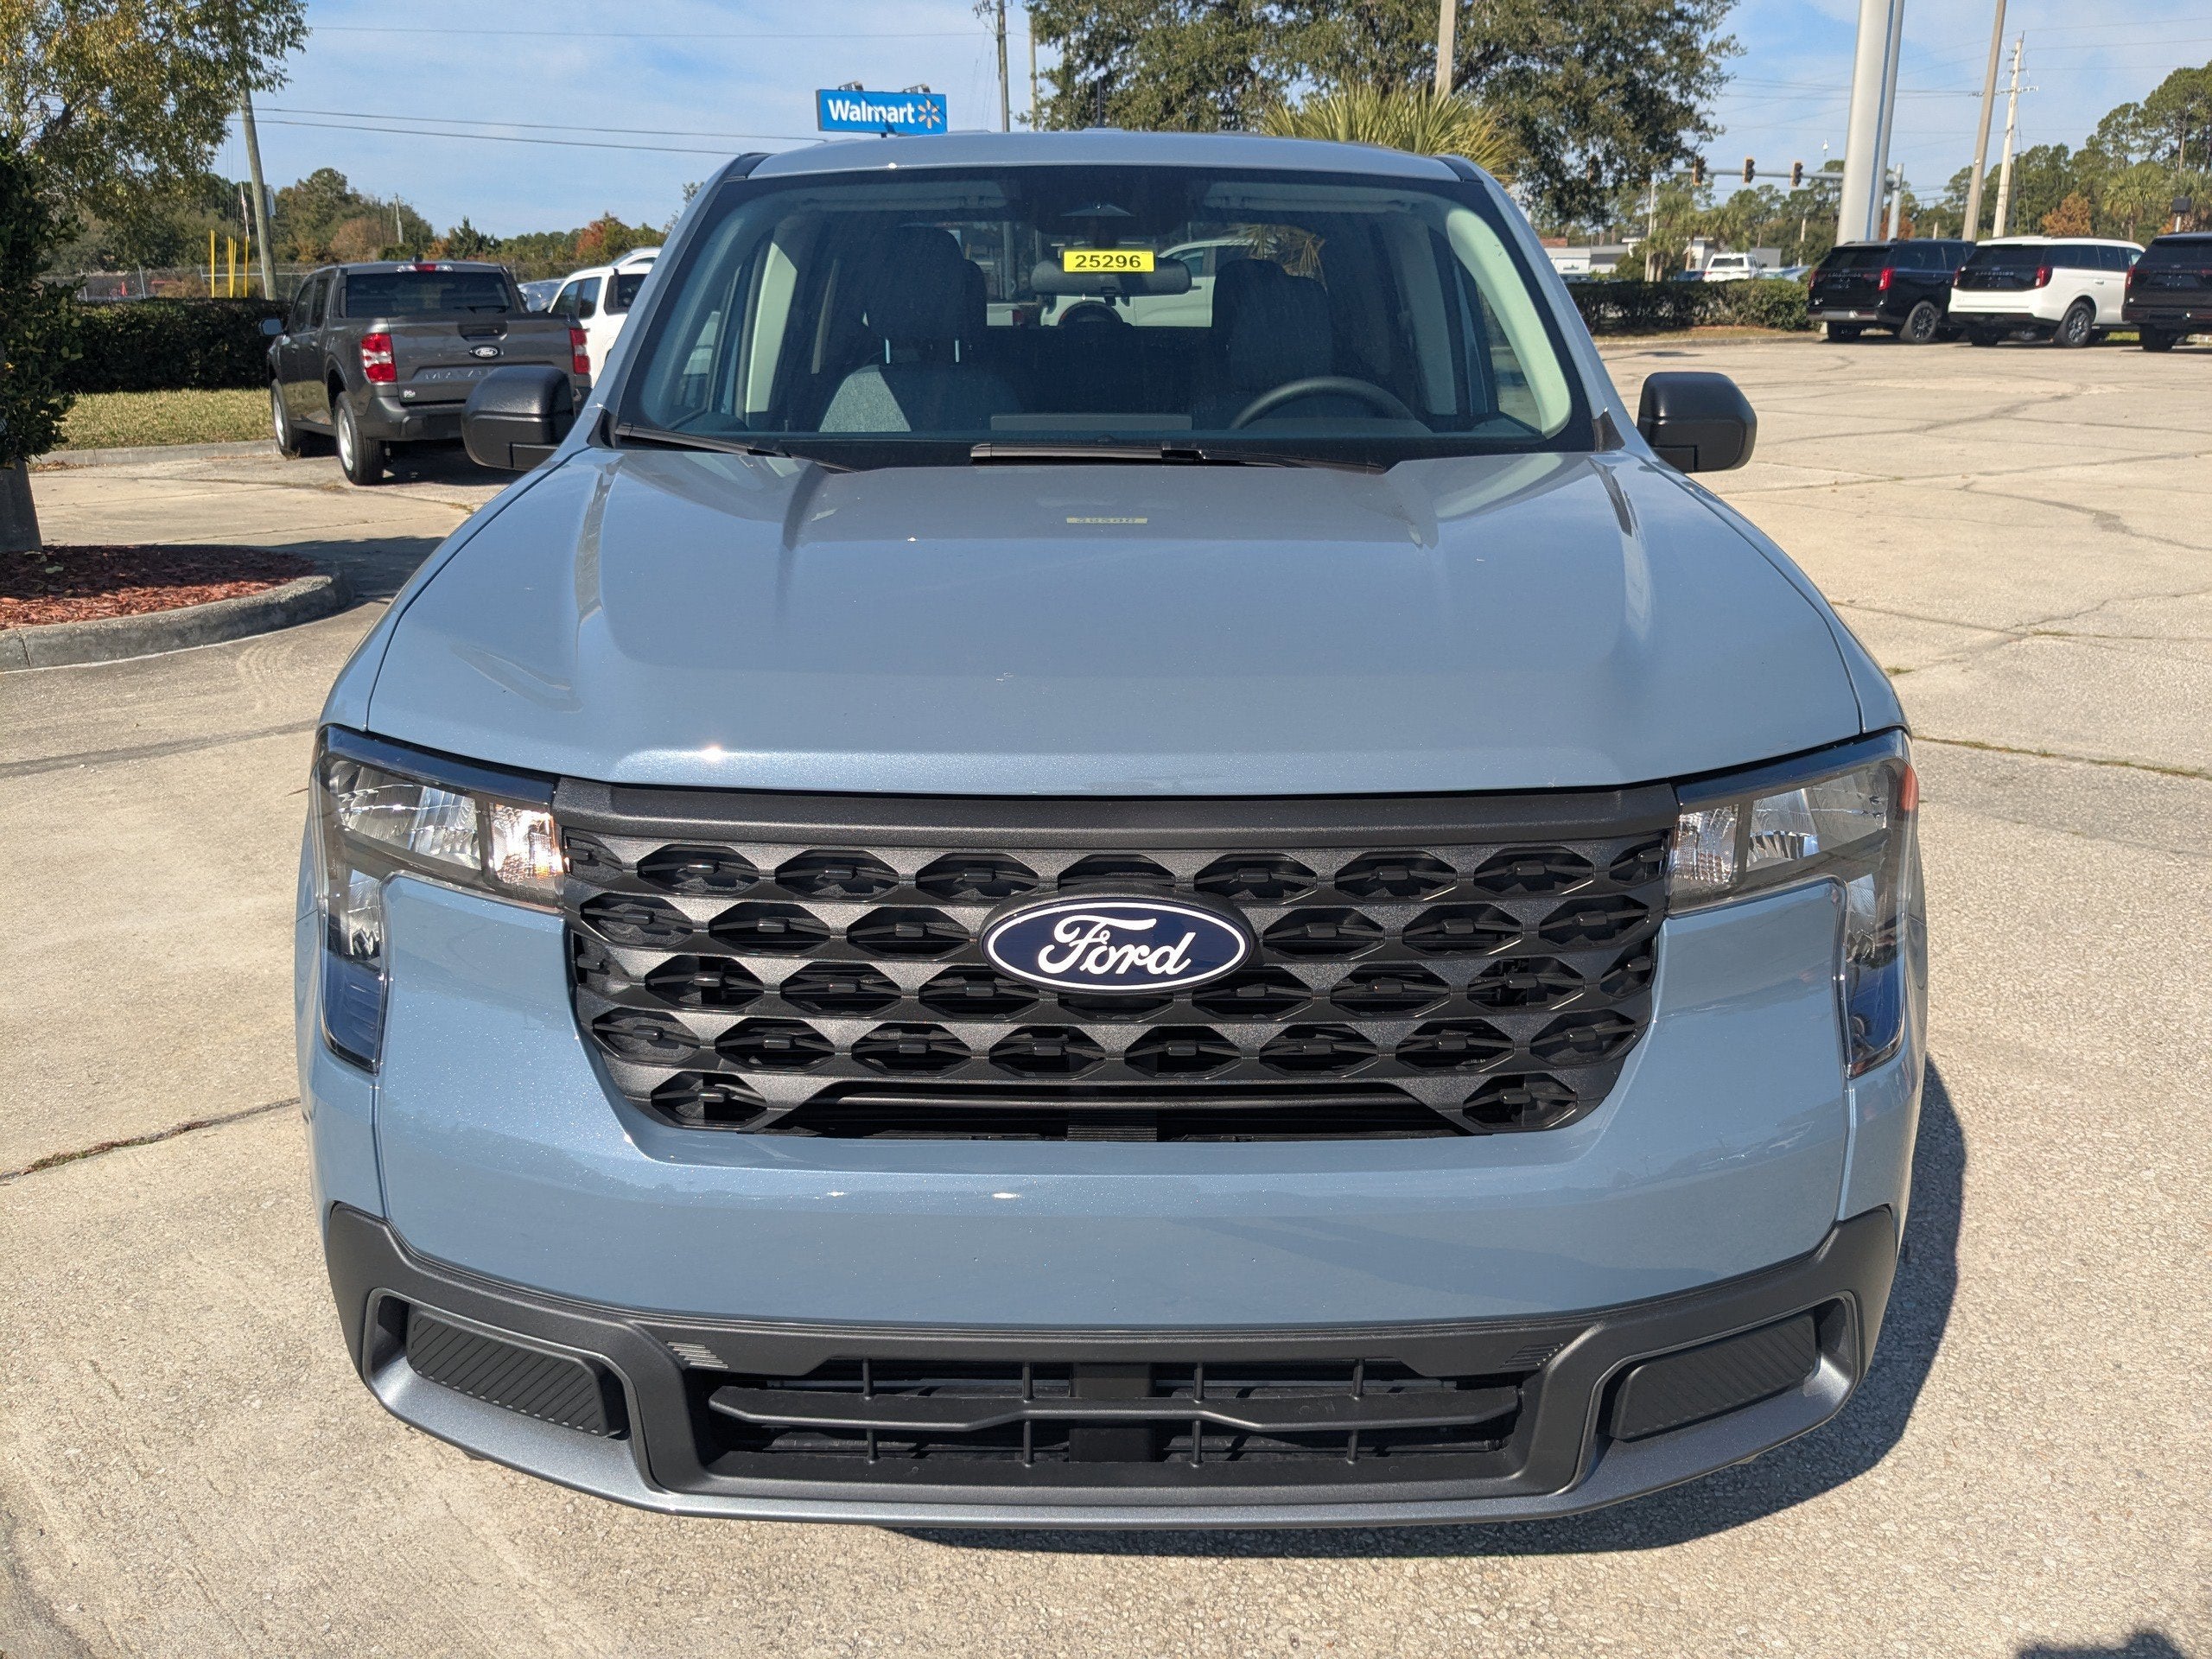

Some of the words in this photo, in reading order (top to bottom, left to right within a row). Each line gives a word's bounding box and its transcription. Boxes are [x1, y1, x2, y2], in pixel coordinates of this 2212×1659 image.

[828, 99, 915, 124] Walmart
[1075, 255, 1141, 268] 25296
[1038, 914, 1196, 975] Ford
